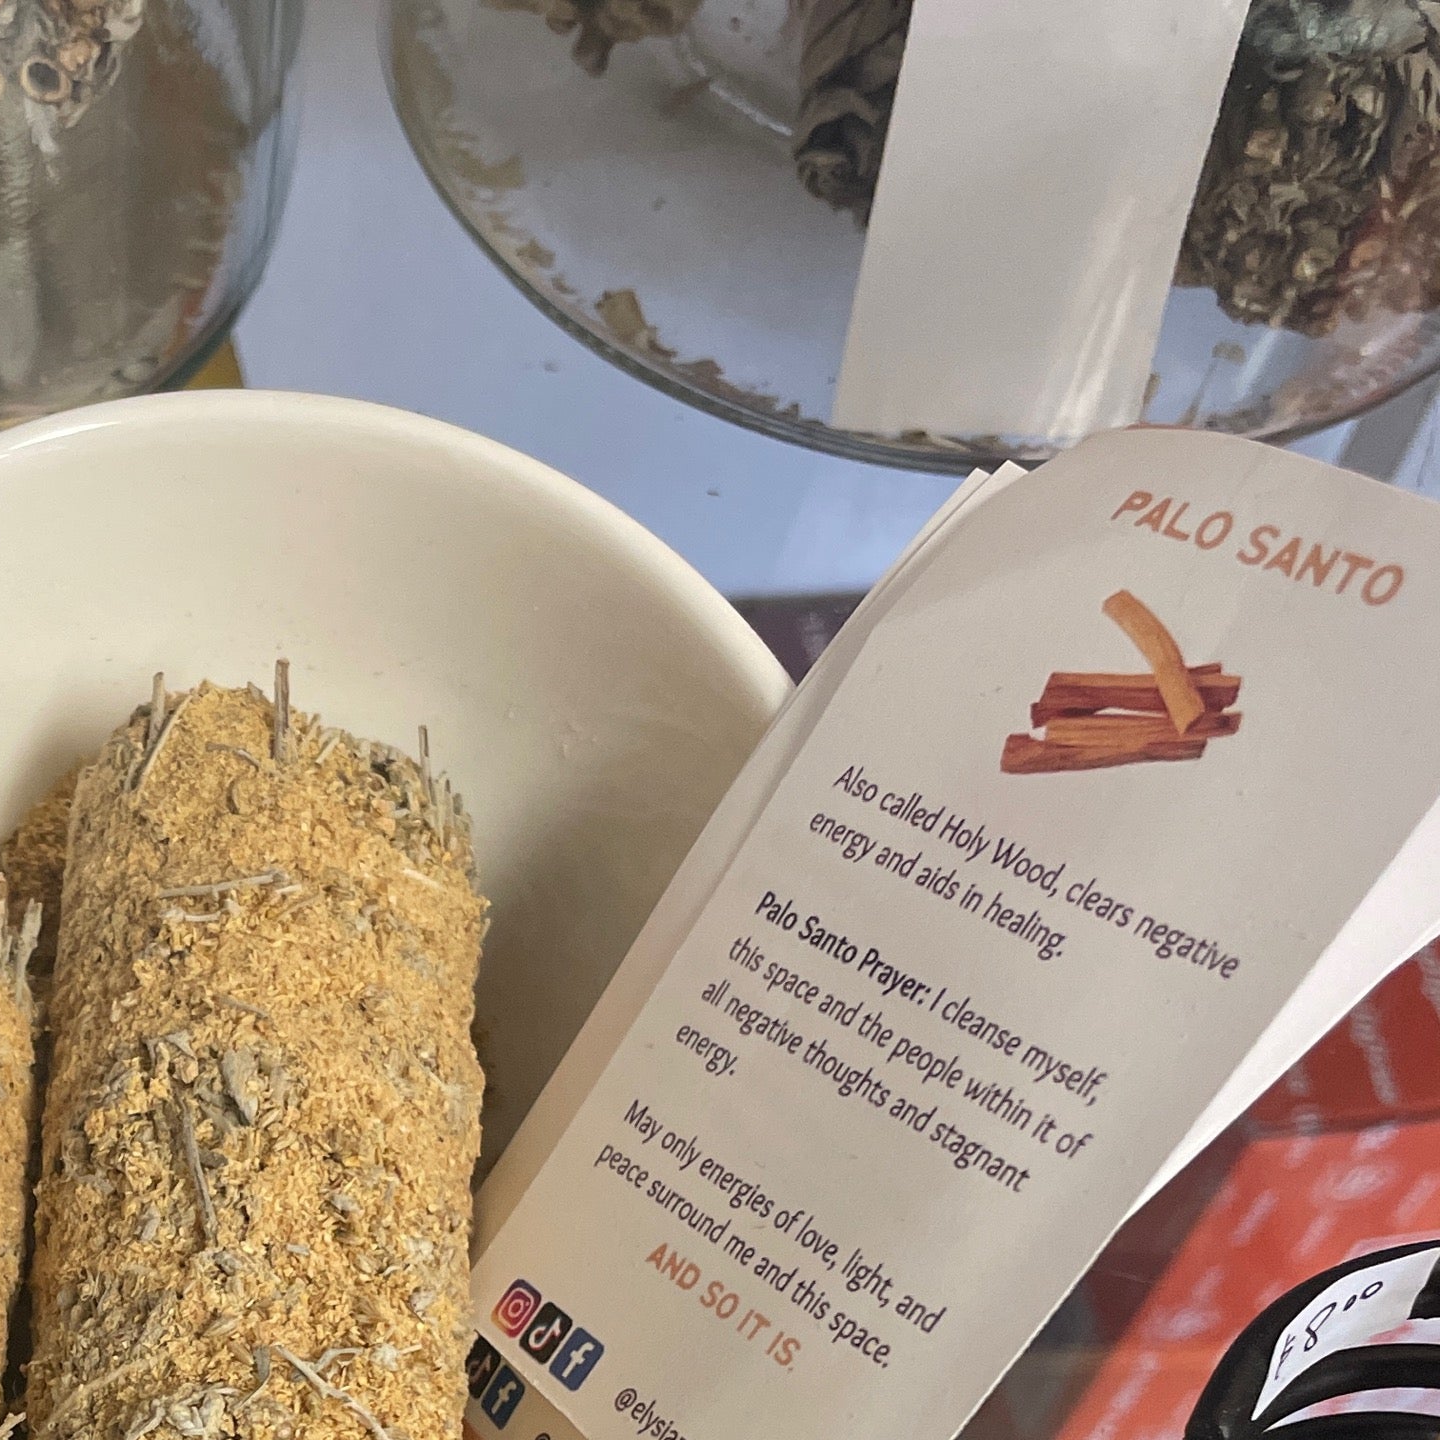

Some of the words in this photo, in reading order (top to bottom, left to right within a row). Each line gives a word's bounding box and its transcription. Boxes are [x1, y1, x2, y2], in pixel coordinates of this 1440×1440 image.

[1112, 490, 1234, 550] PALO
[1236, 525, 1405, 606] SANTO
[810, 813, 878, 863] energy
[875, 847, 923, 879] and
[915, 867, 960, 900] aids
[959, 884, 984, 914] in
[981, 891, 1068, 961] healing.
[832, 765, 879, 803] Also
[879, 792, 946, 833] called
[937, 814, 991, 863] Holy
[990, 837, 1066, 898] Wood,
[1066, 878, 1135, 927] clears
[1133, 916, 1240, 980] negative
[676, 1025, 738, 1077] energy.
[701, 979, 731, 1007] all
[724, 995, 803, 1054] negative
[803, 1039, 891, 1107] thoughts
[889, 1098, 938, 1133] and
[929, 1123, 1030, 1193] stagnant
[729, 936, 765, 972] this
[763, 962, 820, 1005] space
[818, 994, 865, 1027] and
[858, 1011, 894, 1048] the
[886, 1037, 964, 1089] people
[963, 1077, 1032, 1130] within
[1031, 1114, 1057, 1144] it
[1056, 1133, 1094, 1159] of
[754, 891, 799, 931] Palo
[798, 916, 858, 964] Santo
[856, 948, 932, 1006] Prayer:
[929, 988, 947, 1012] I
[941, 997, 1023, 1056] cleanse
[1020, 1045, 1108, 1107] myself,
[594, 1144, 649, 1189] peace
[646, 1180, 732, 1245] surround
[723, 1234, 755, 1266] me
[753, 1257, 800, 1292] and
[791, 1280, 831, 1320] this
[828, 1312, 891, 1368] space.
[624, 1099, 663, 1142] May
[661, 1132, 702, 1171] only
[699, 1158, 775, 1218] energies
[774, 1210, 805, 1233] of
[794, 1215, 839, 1271] love,
[840, 1248, 894, 1308] light,
[895, 1295, 947, 1334] and
[645, 1243, 700, 1290] AND
[700, 1281, 739, 1319] SO
[737, 1310, 771, 1340] IT
[766, 1332, 800, 1371] IS.
